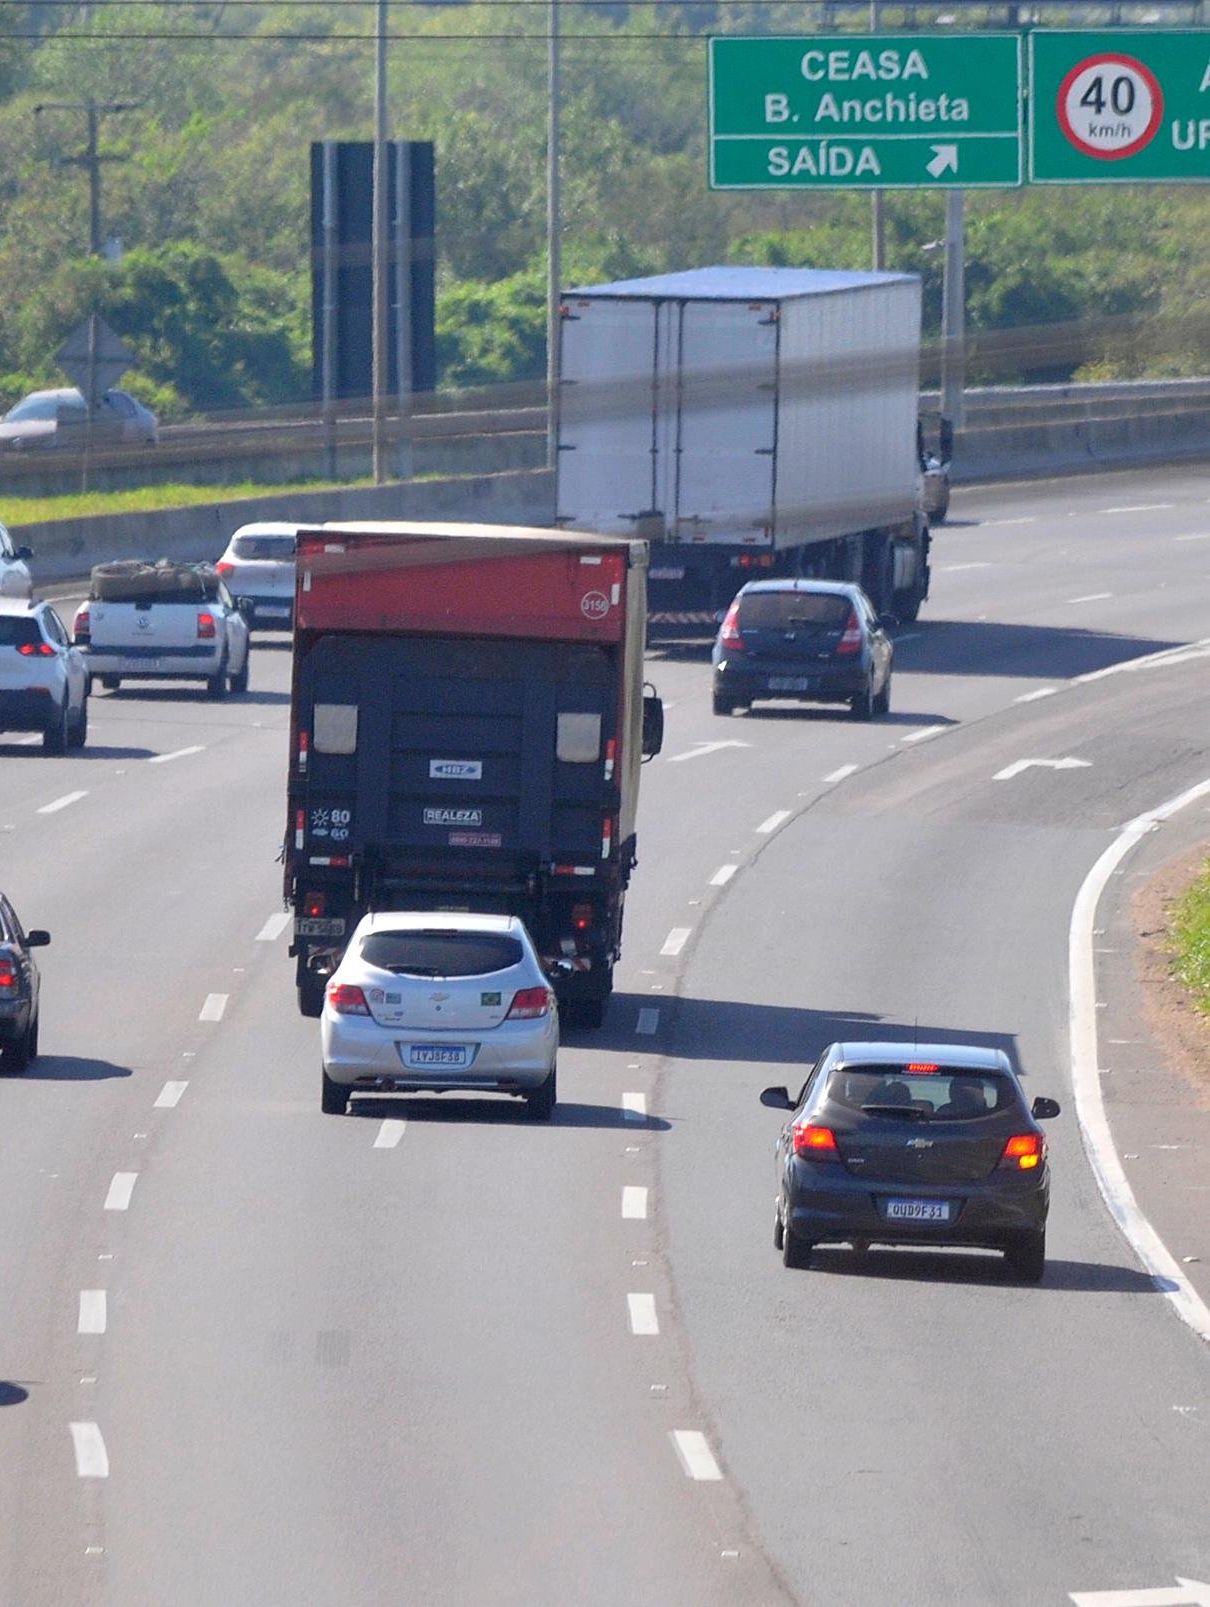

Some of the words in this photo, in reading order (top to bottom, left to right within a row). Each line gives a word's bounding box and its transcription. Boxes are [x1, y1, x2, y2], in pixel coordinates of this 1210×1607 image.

[800, 49, 929, 81] CEASA
[764, 94, 800, 122] B.
[814, 92, 970, 122] Anchieta
[1080, 75, 1136, 116] 40
[1089, 121, 1131, 139] km/h
[767, 140, 881, 176] SAÍDA
[331, 809, 351, 824] 80
[427, 811, 479, 821] REALEZA
